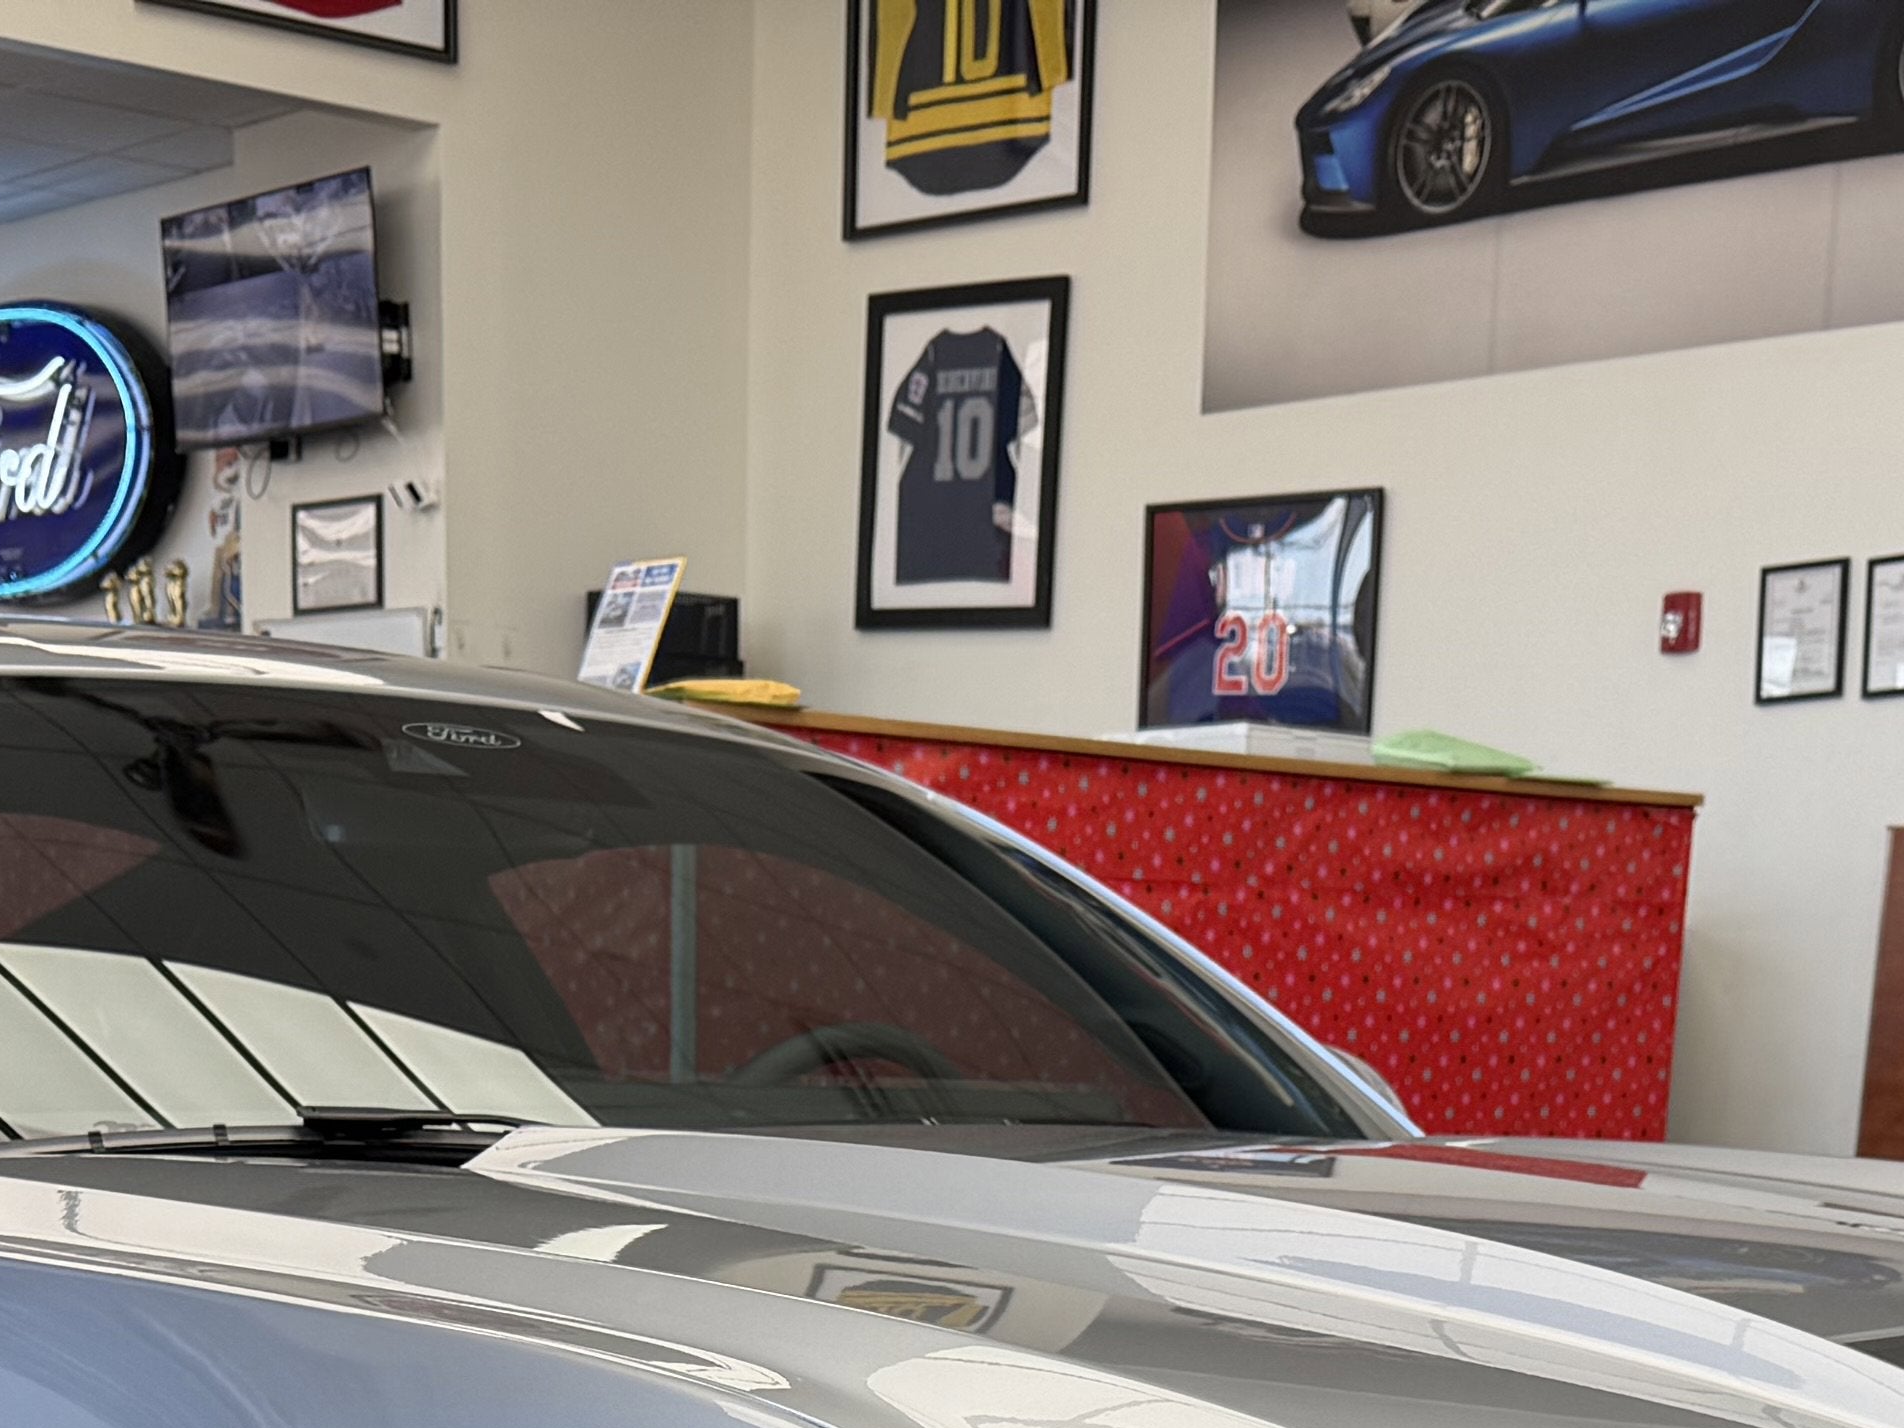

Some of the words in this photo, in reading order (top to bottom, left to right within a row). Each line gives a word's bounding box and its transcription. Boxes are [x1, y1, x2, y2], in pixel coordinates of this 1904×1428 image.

[933, 396, 995, 482] 10
[1212, 608, 1290, 696] 20
[425, 726, 502, 746] Ford
